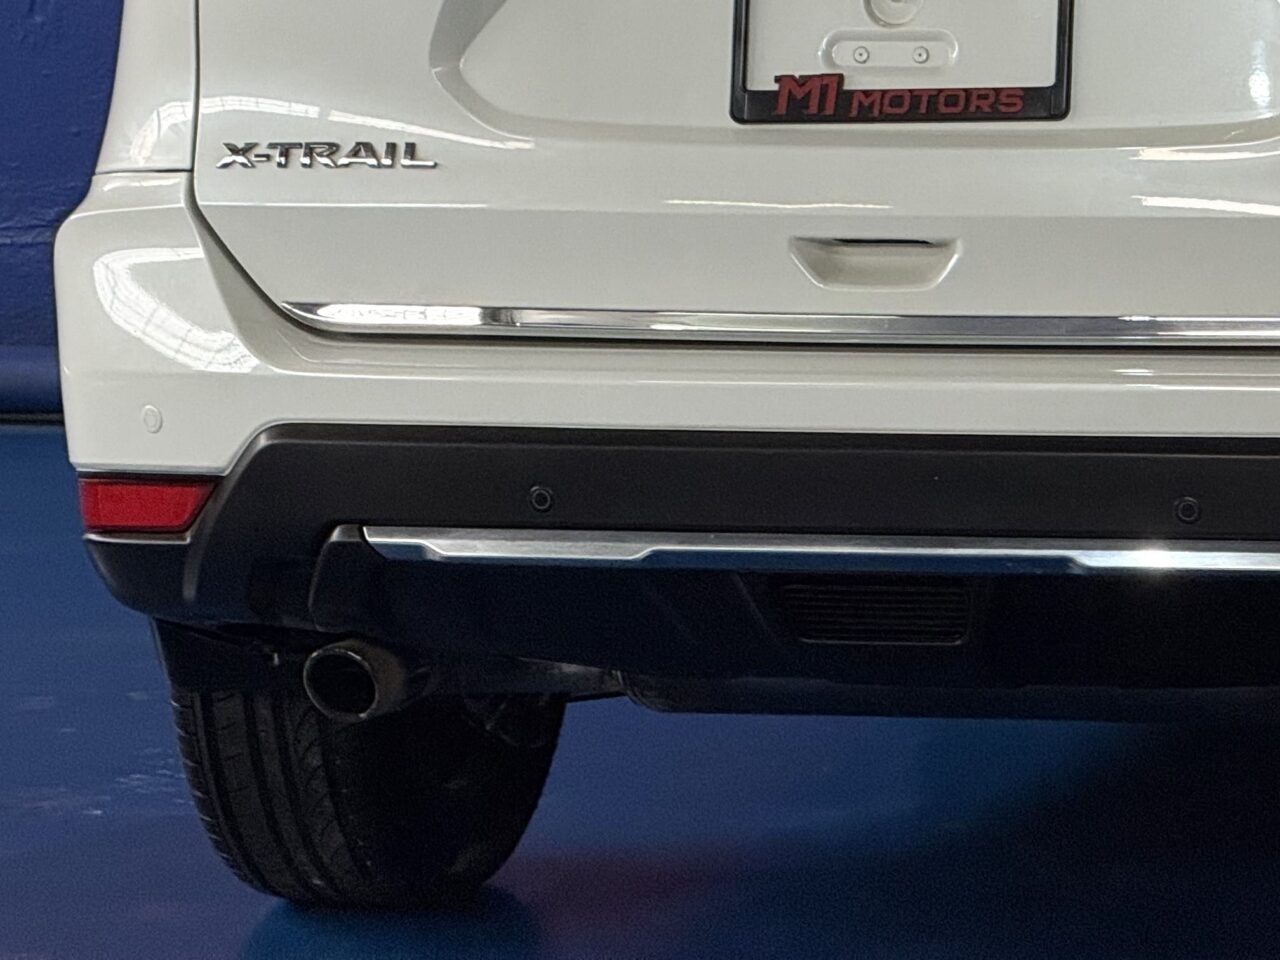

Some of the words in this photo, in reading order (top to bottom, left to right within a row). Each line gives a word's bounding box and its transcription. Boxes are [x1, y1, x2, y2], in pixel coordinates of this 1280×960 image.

[772, 74, 842, 117] M1
[850, 87, 1025, 118] MOTORS
[215, 141, 438, 169] X-TRAIL
